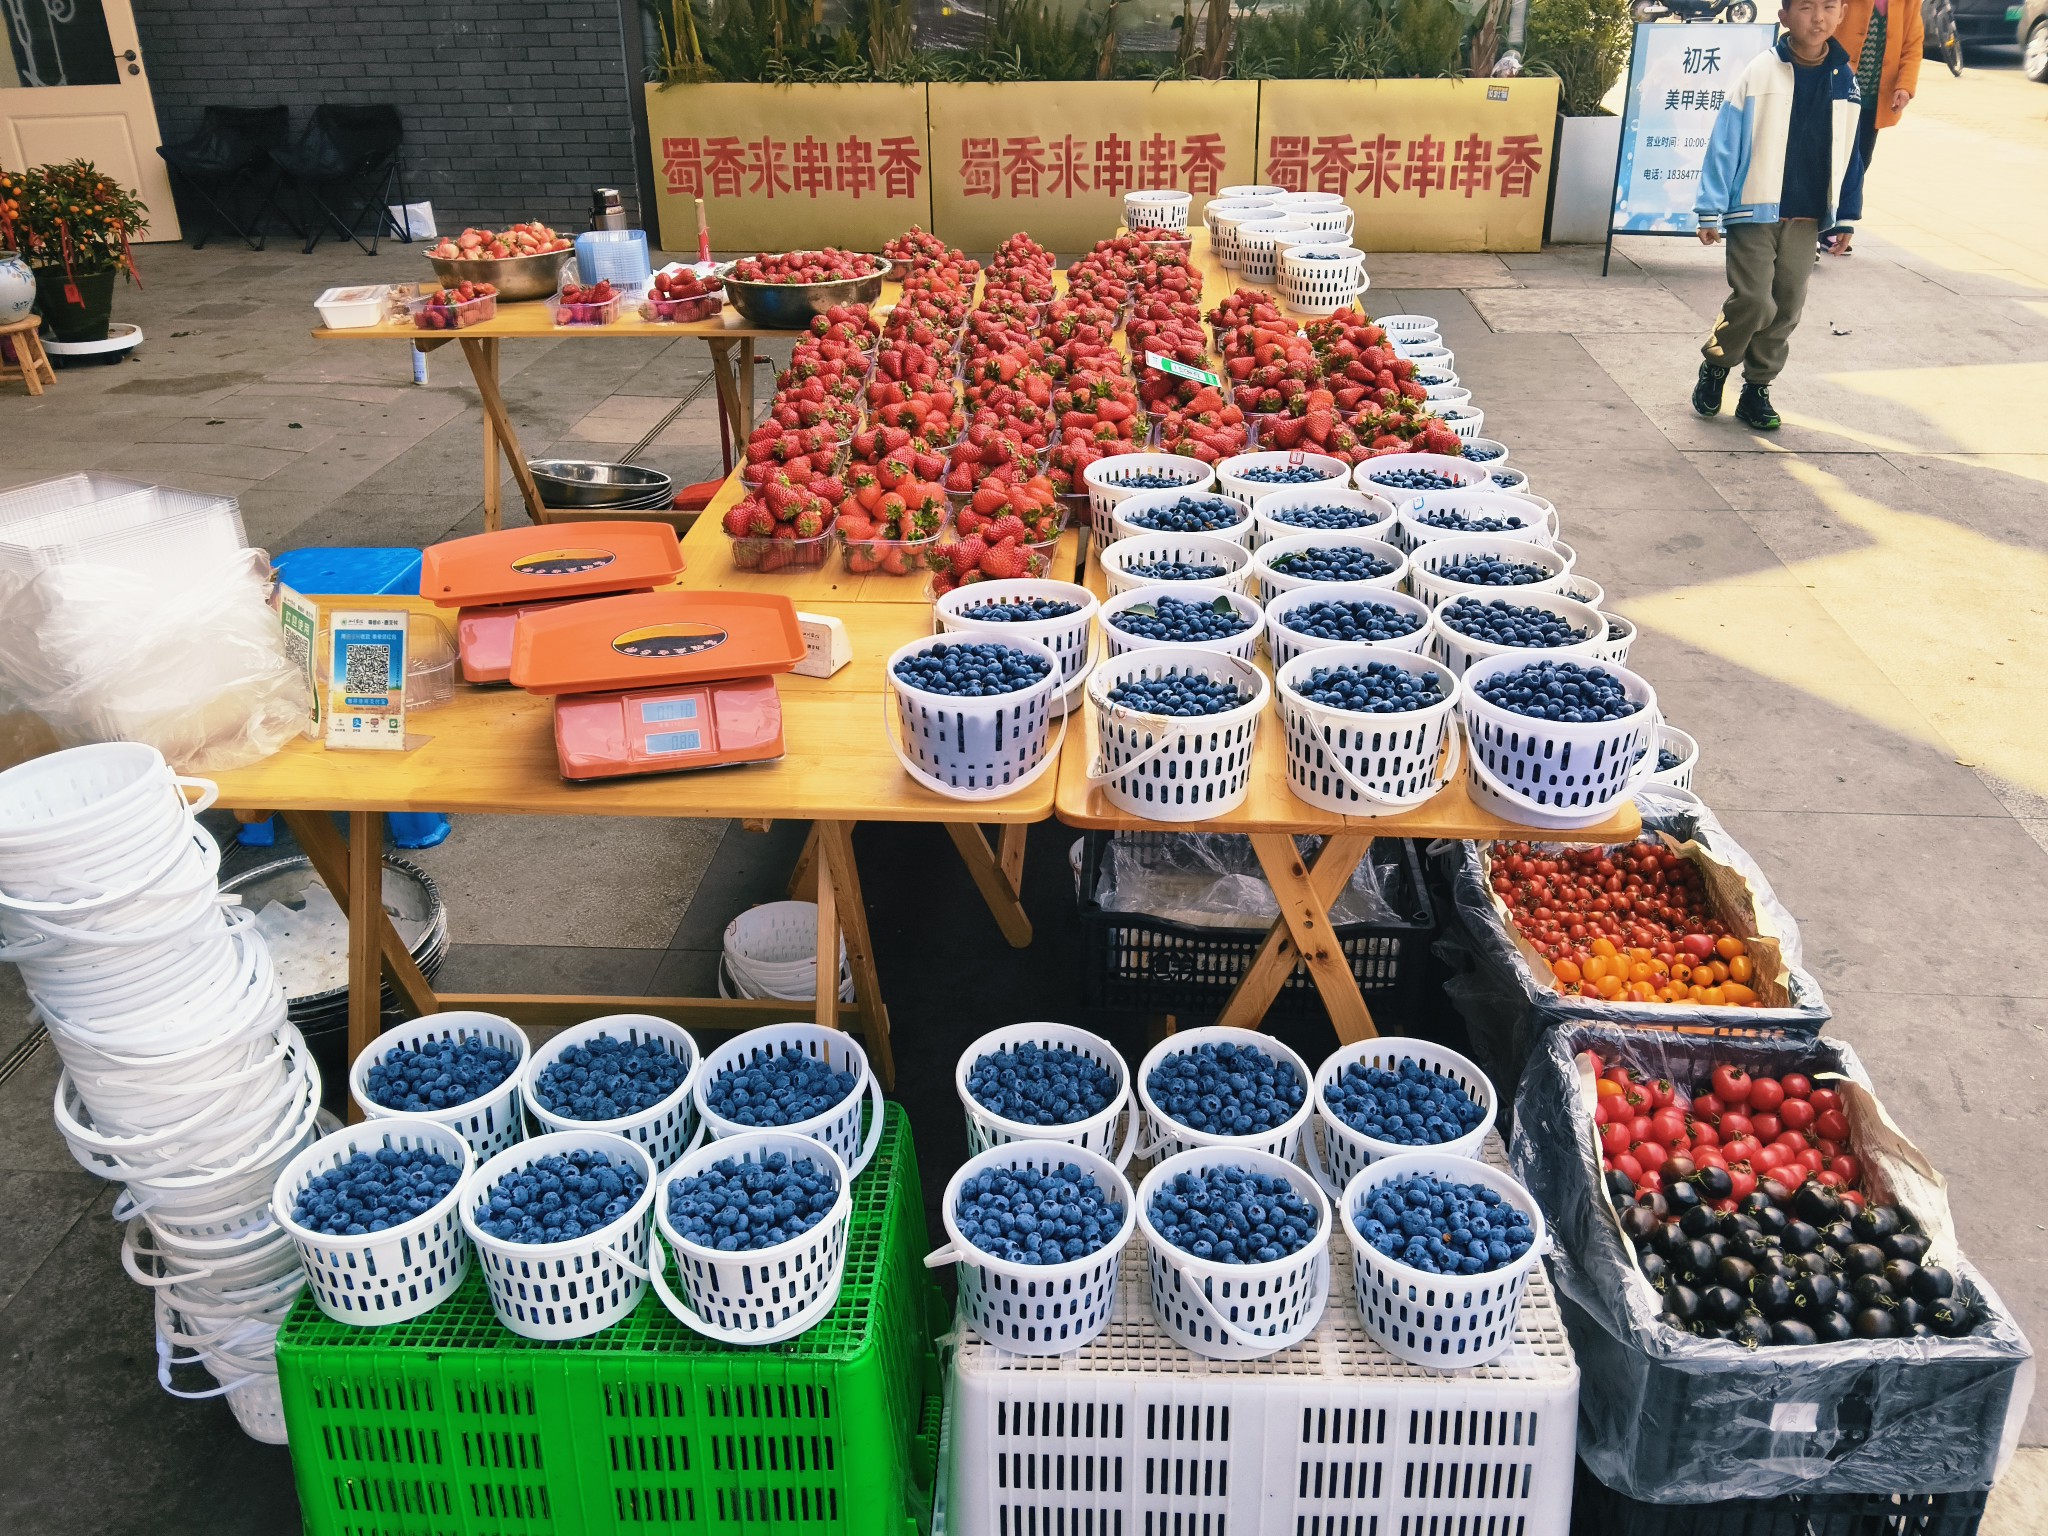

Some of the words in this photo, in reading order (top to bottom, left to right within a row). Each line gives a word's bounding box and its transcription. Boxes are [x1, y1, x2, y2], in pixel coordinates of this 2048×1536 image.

[1682, 46, 1721, 74] 初禾
[661, 135, 922, 199] 蜀香来串串香
[958, 132, 1227, 200] 蜀香来串串香
[1264, 132, 1543, 198] 蜀香来串串香
[1646, 136, 1710, 148] 营业时间：10:00-
